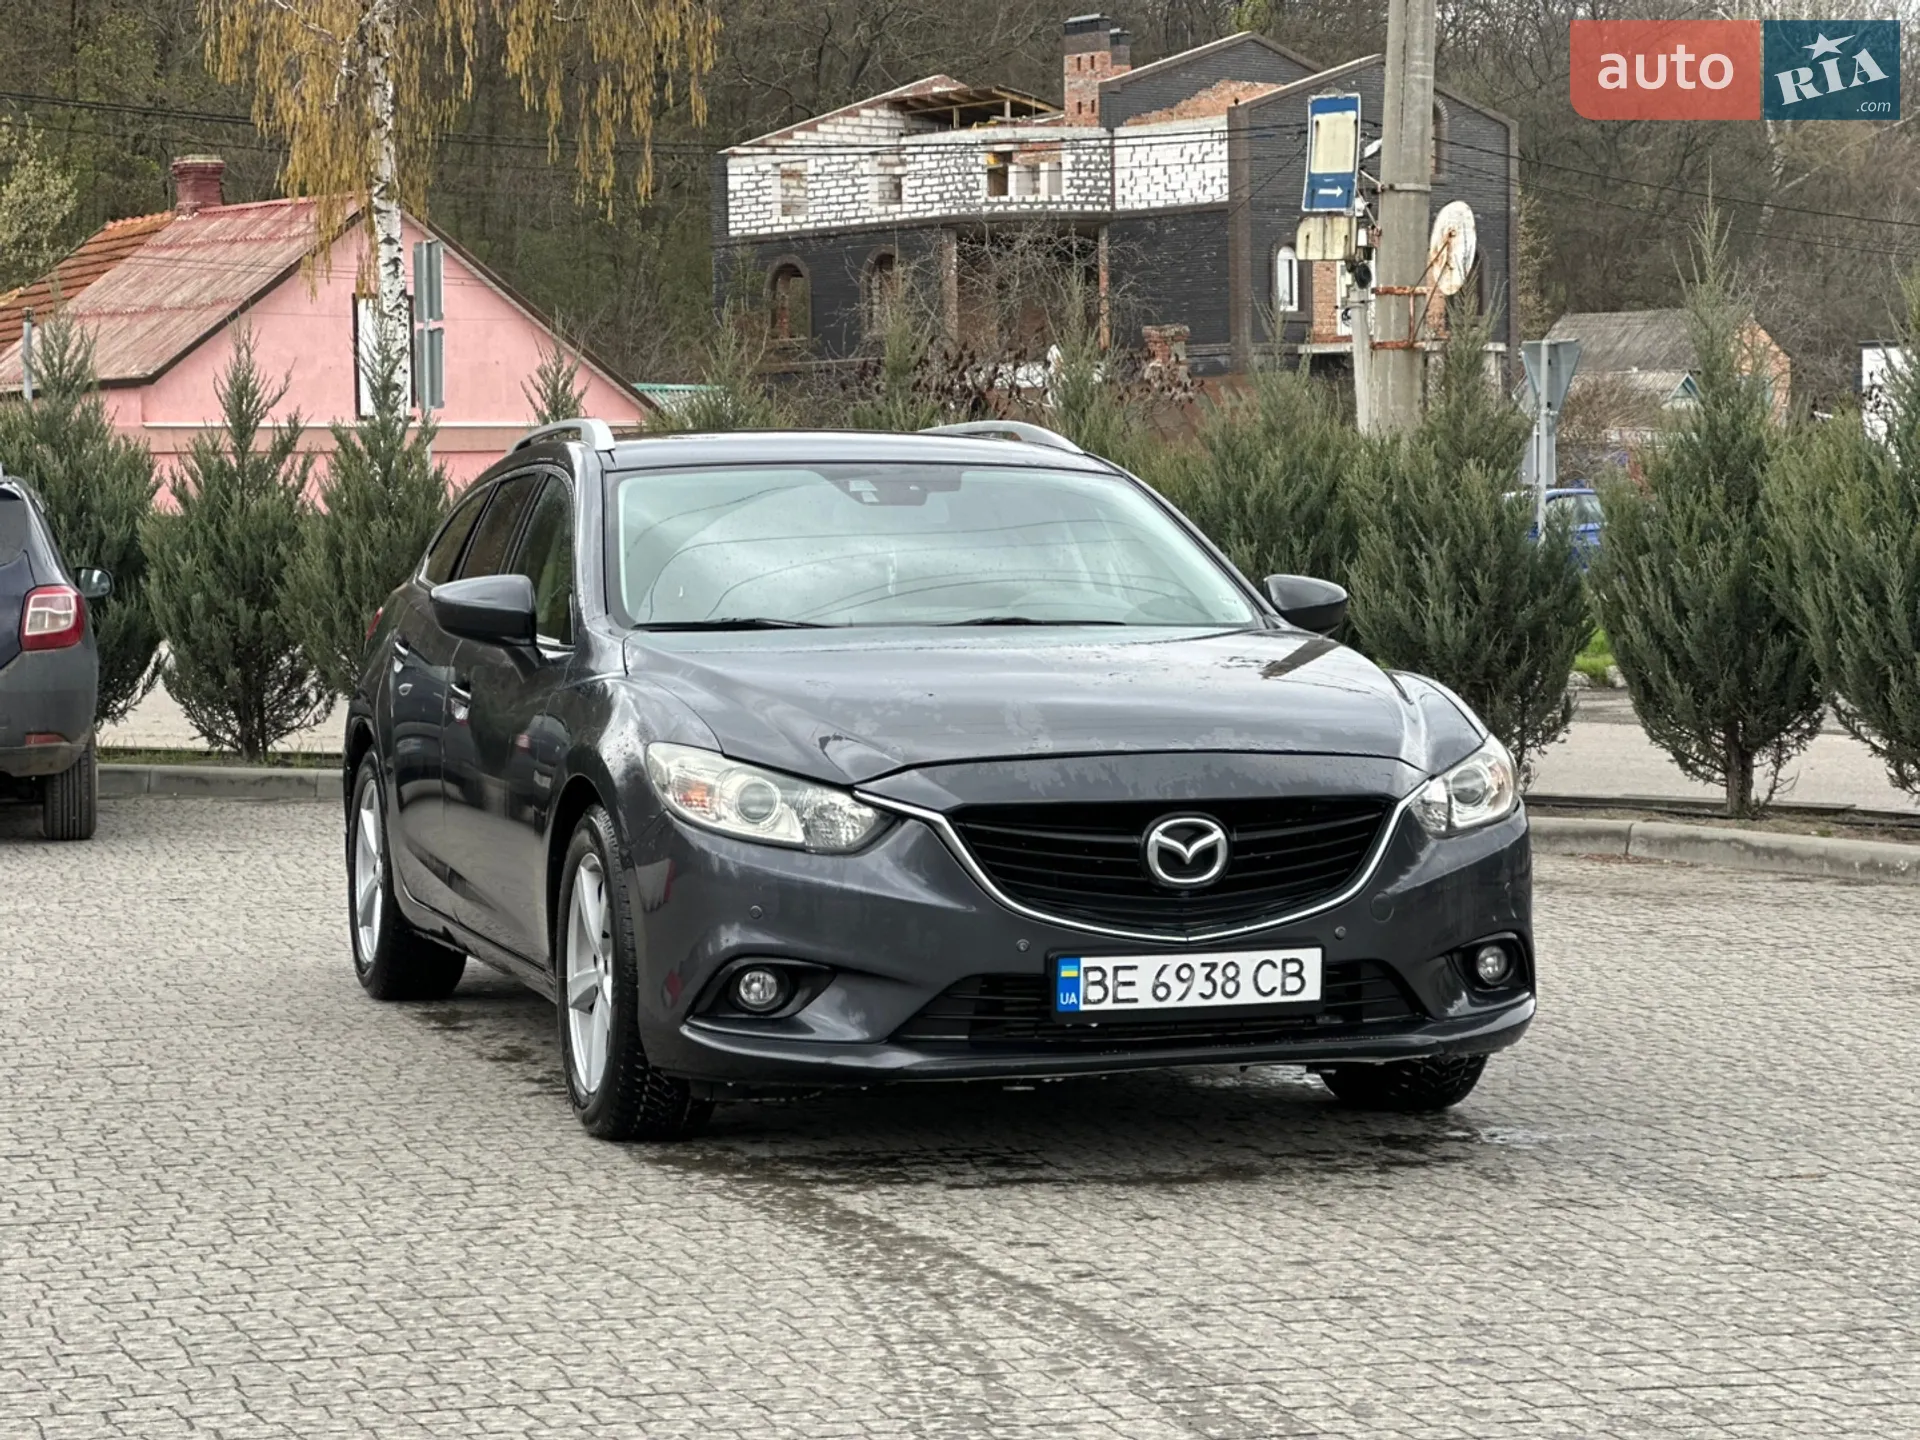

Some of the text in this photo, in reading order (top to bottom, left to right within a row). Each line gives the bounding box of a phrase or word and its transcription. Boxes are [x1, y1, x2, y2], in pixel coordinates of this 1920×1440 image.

[1082, 957, 1307, 1006] BE 6938 CB
[1060, 992, 1078, 1005] UA
